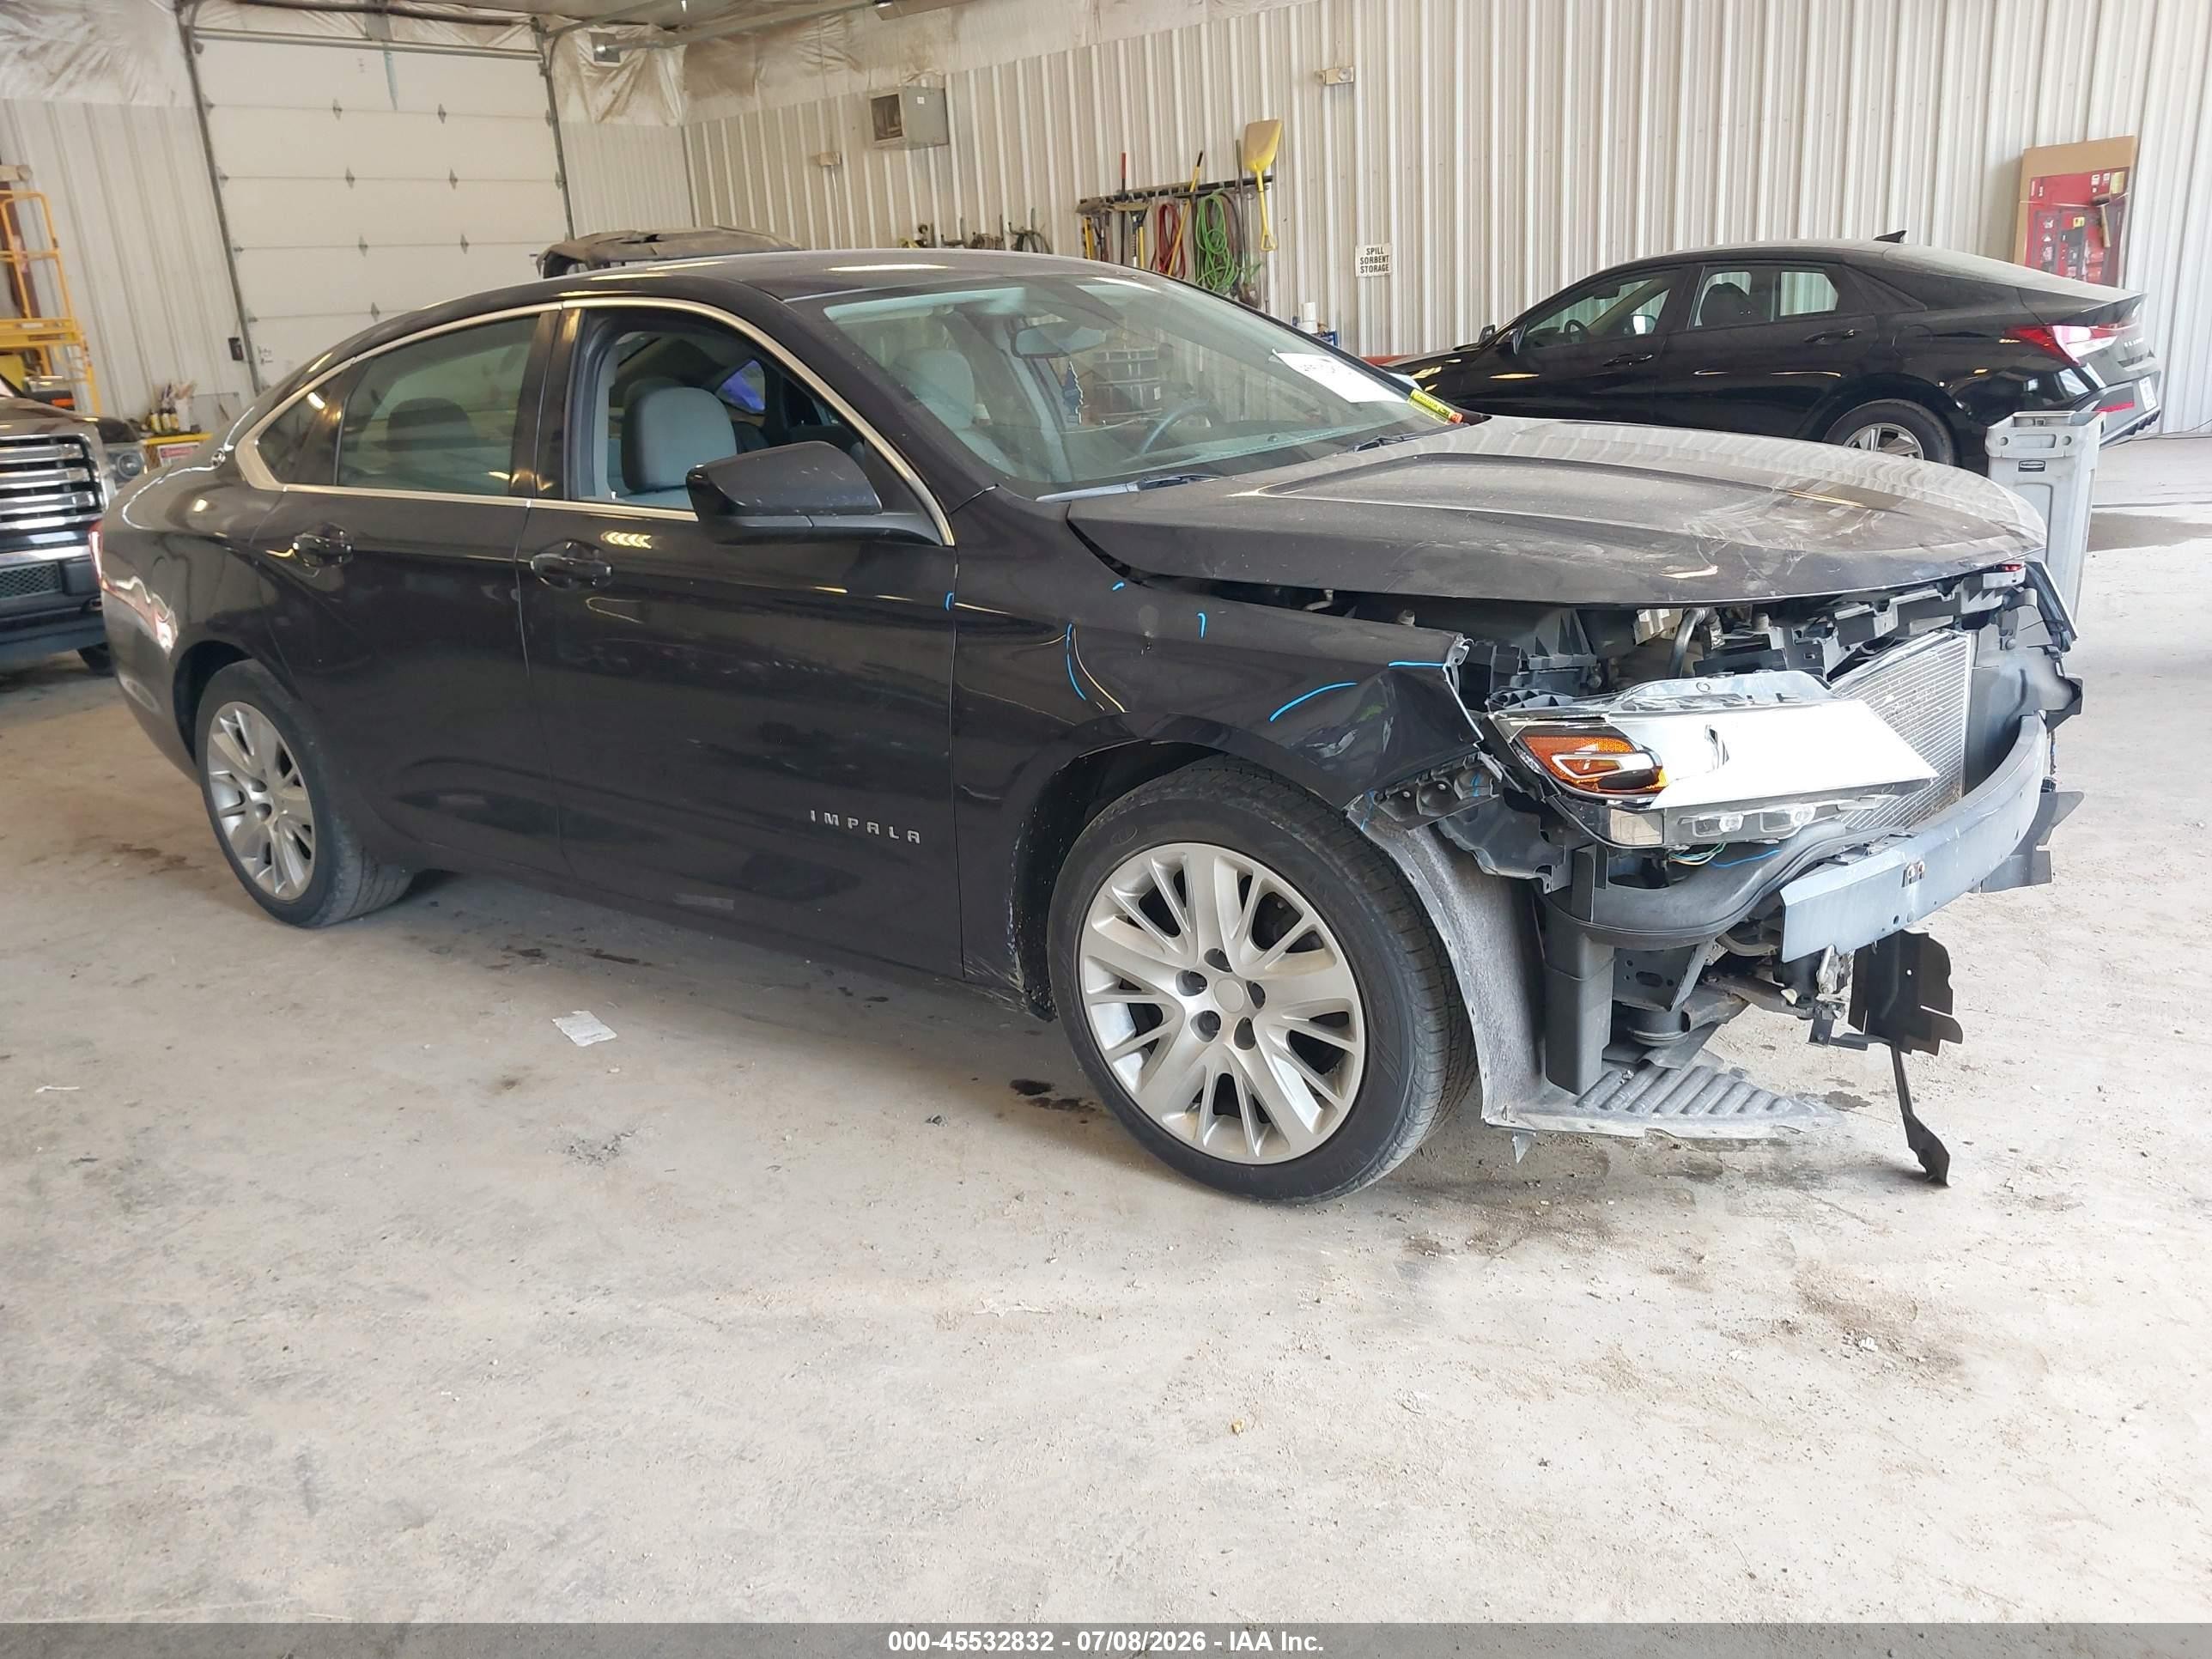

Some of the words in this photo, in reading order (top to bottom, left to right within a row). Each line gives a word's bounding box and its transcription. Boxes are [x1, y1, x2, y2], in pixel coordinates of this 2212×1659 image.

[1366, 246, 1384, 255] SPILL
[1359, 255, 1389, 264] SORBENT
[1359, 264, 1389, 274] STORAGE
[810, 810, 921, 844] IMPALA
